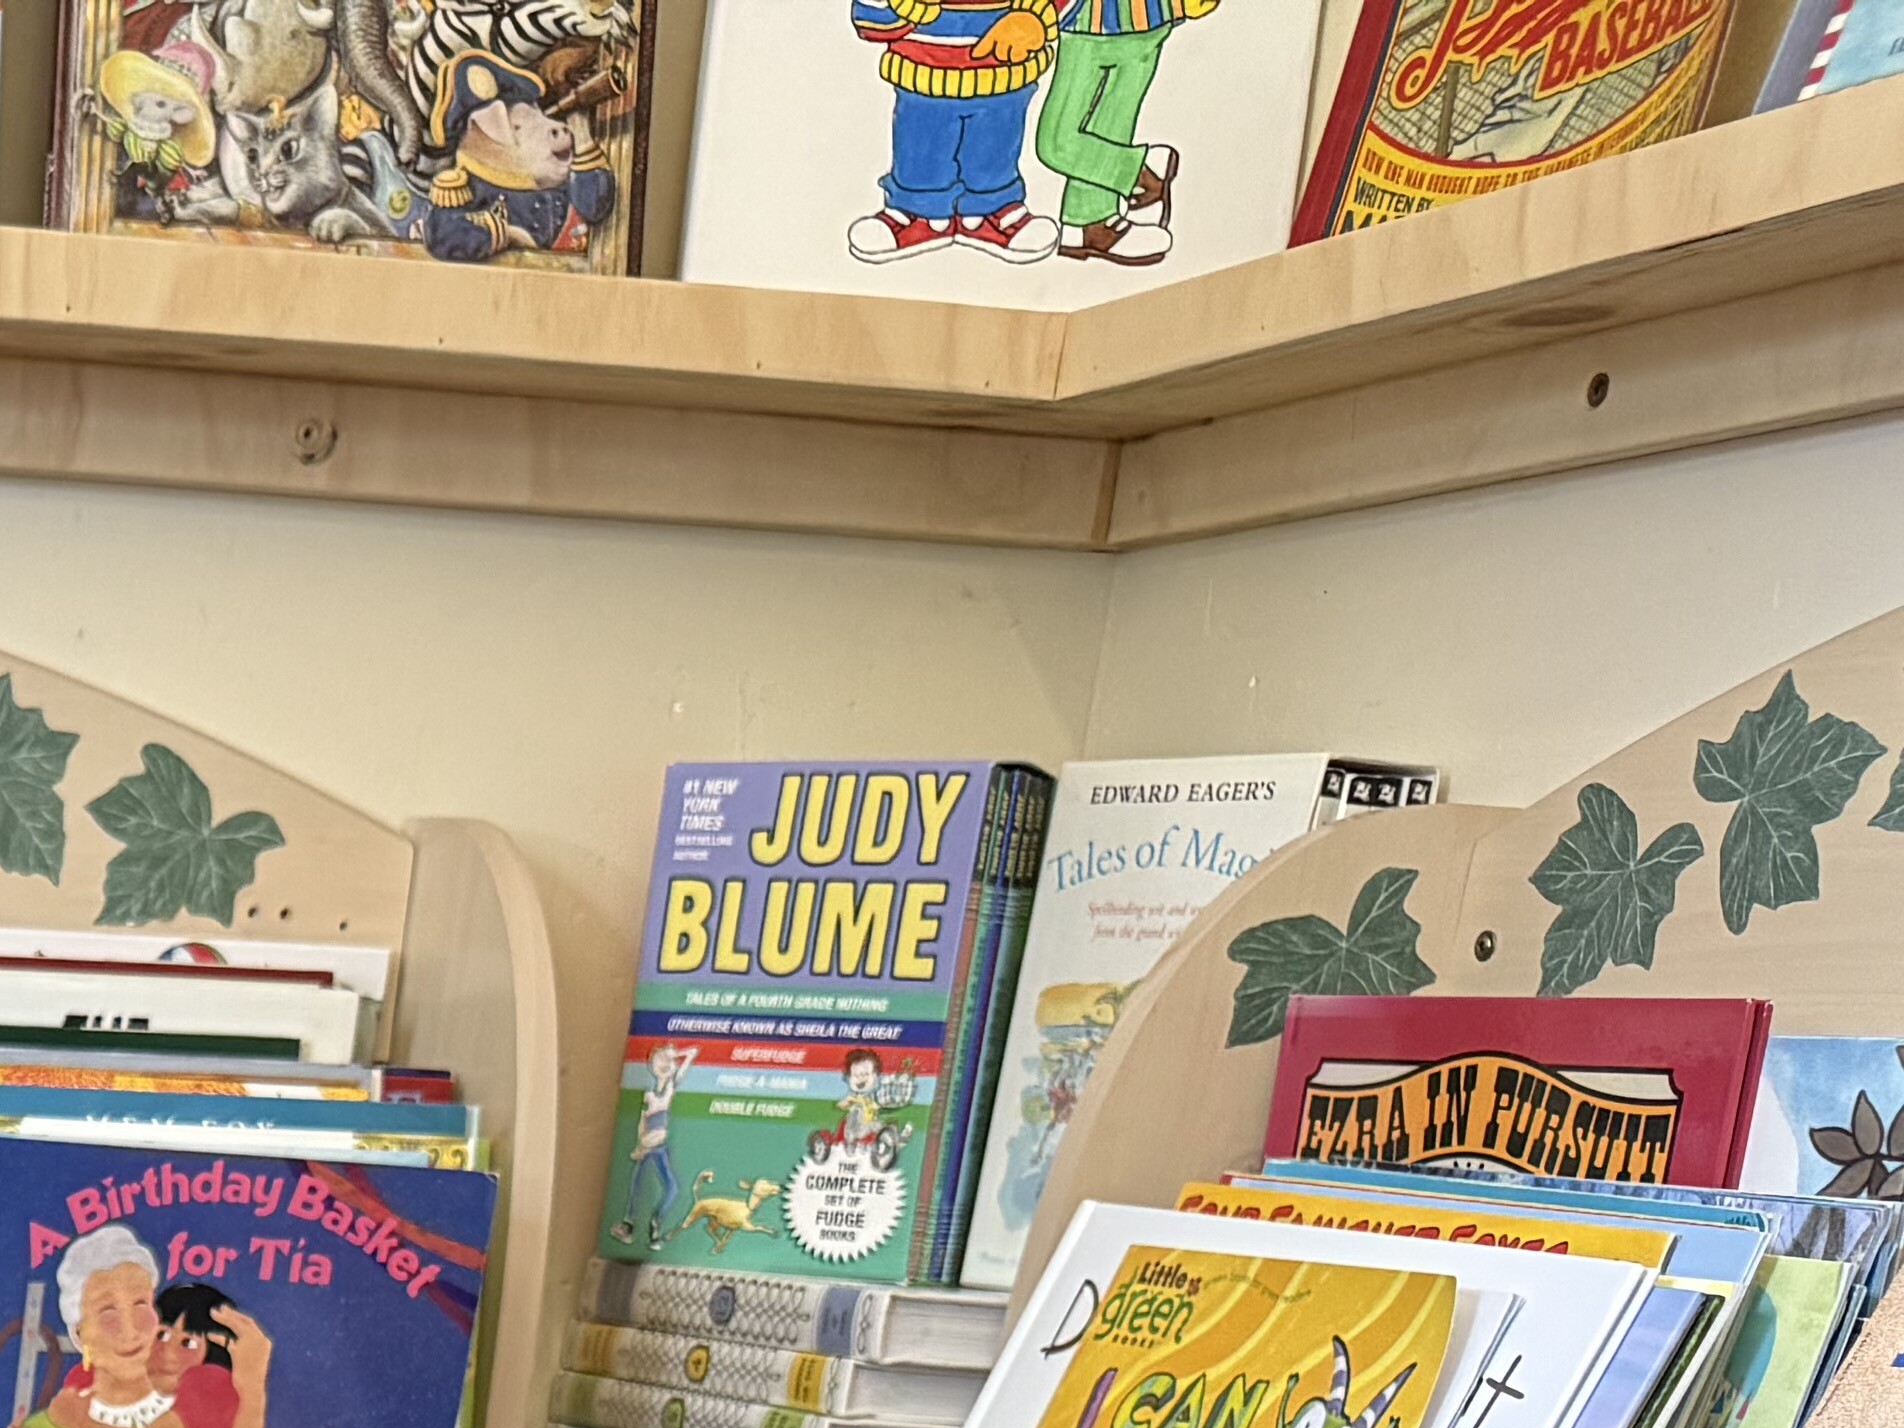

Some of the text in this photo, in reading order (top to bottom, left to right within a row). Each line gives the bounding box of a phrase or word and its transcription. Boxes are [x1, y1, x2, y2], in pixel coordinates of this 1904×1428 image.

[682, 797, 721, 812] YORK
[1091, 781, 1276, 805] EDWARD EAGER'S
[679, 816, 724, 831] TIMES
[749, 772, 970, 866] JUDY
[657, 878, 949, 980] BLUME
[730, 1049, 807, 1063] SUPERFUDGE
[1301, 1064, 1672, 1185] EZRA IN PURSUIT
[805, 1175, 887, 1195] COMPLETE
[29, 1160, 442, 1299] A Birthday Basket
[815, 1210, 865, 1228] FUDGE
[1094, 1287, 1195, 1344] green
